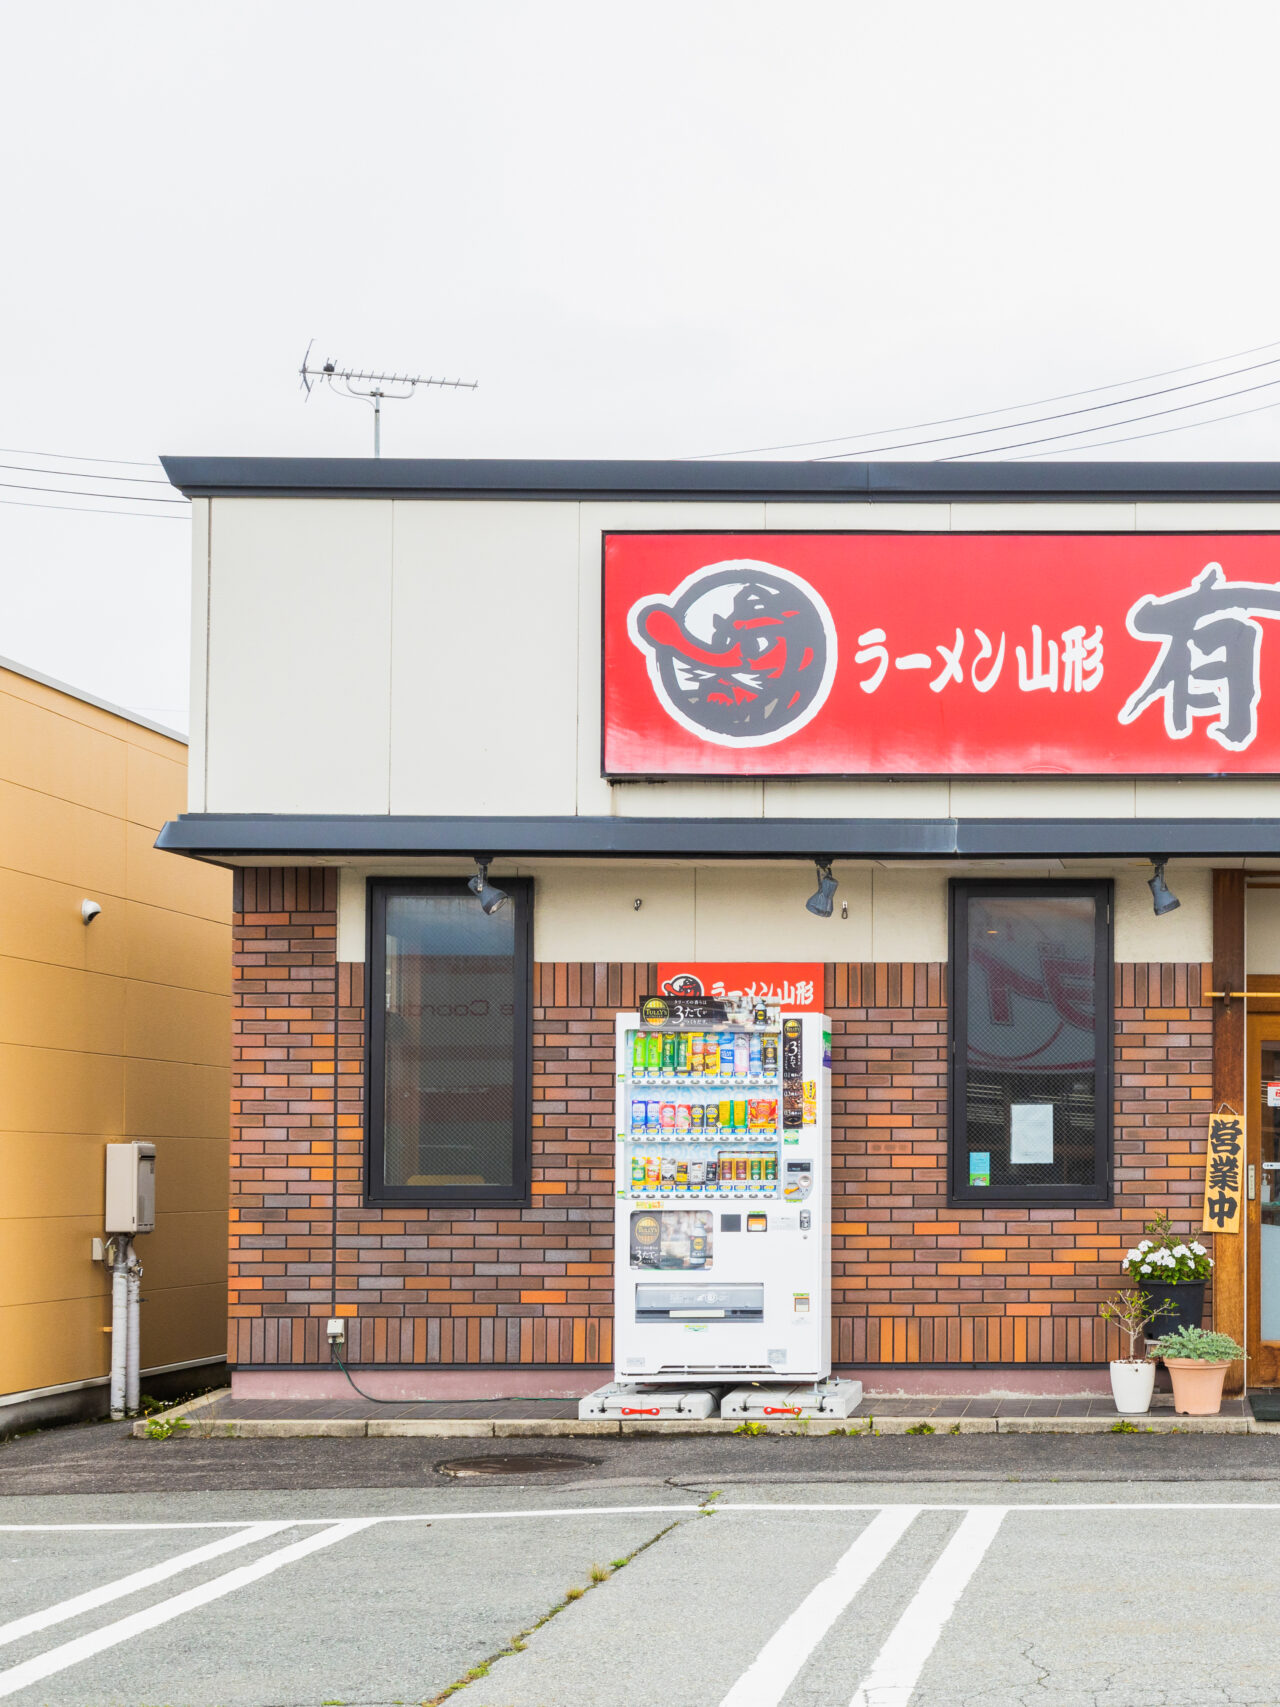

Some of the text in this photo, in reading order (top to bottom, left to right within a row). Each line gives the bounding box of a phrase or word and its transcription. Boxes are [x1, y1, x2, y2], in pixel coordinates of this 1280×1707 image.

[855, 624, 1105, 694] ラーメン山形
[1207, 1119, 1243, 1228] 営業中
